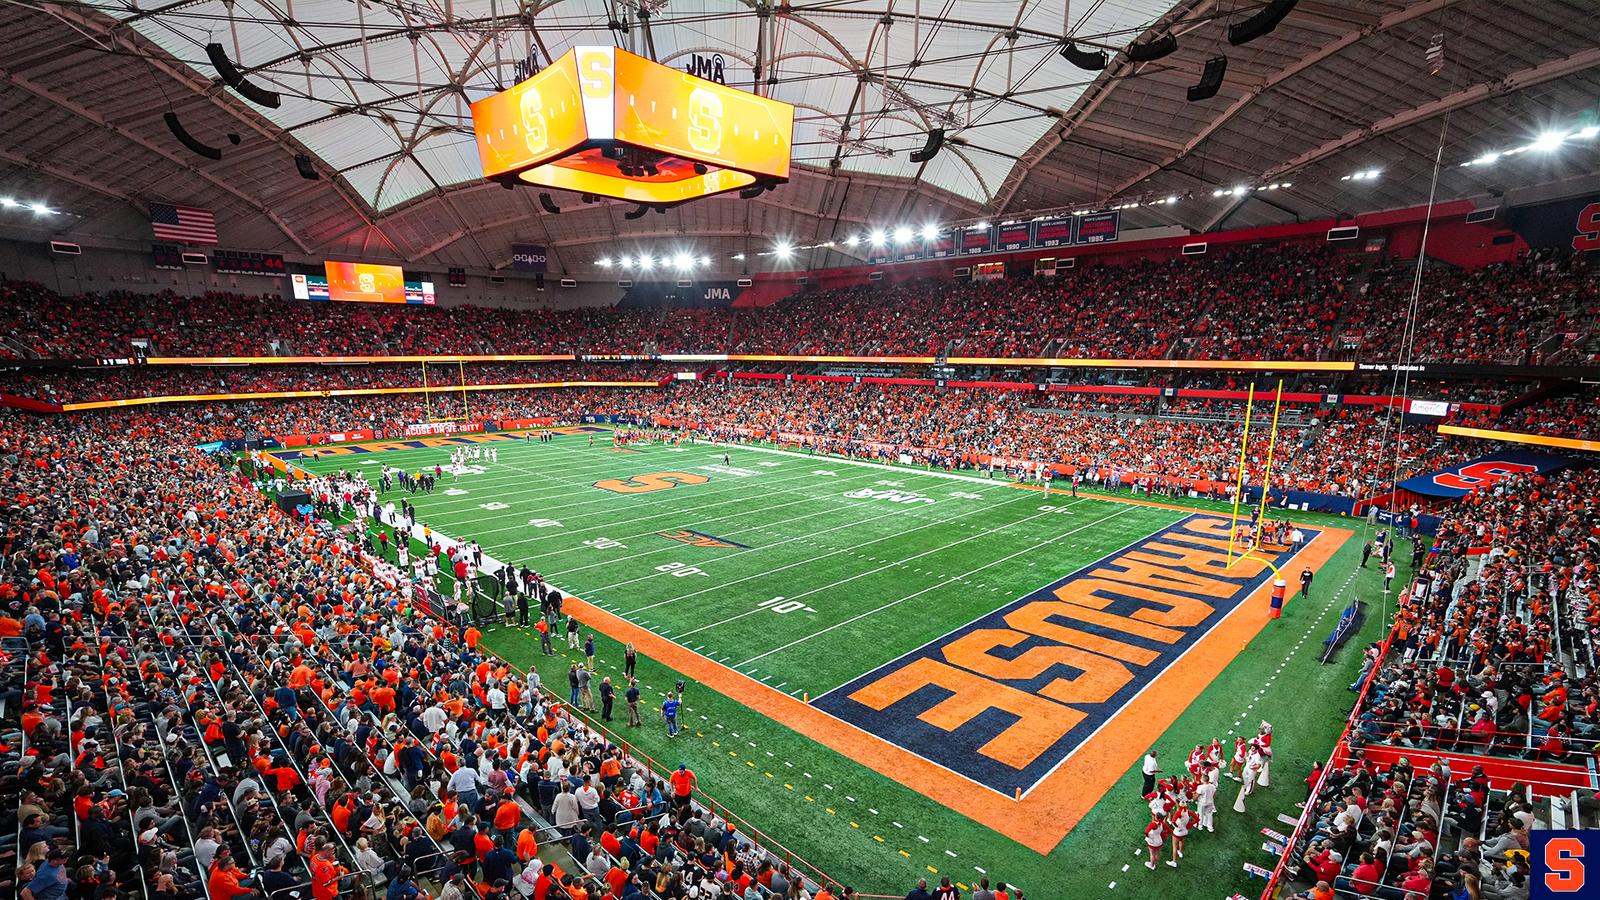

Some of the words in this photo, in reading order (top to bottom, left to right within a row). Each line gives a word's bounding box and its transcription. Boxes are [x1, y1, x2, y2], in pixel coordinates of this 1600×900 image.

[581, 52, 612, 98] S
[686, 53, 725, 86] JMA
[520, 88, 548, 154] S
[688, 88, 723, 155] S
[358, 273, 375, 293] S
[704, 288, 730, 300] JMA
[592, 471, 711, 494] S
[1433, 461, 1539, 489] S
[655, 561, 702, 578] 20
[757, 596, 806, 614] 10
[847, 518, 1292, 771] SYRACUSE
